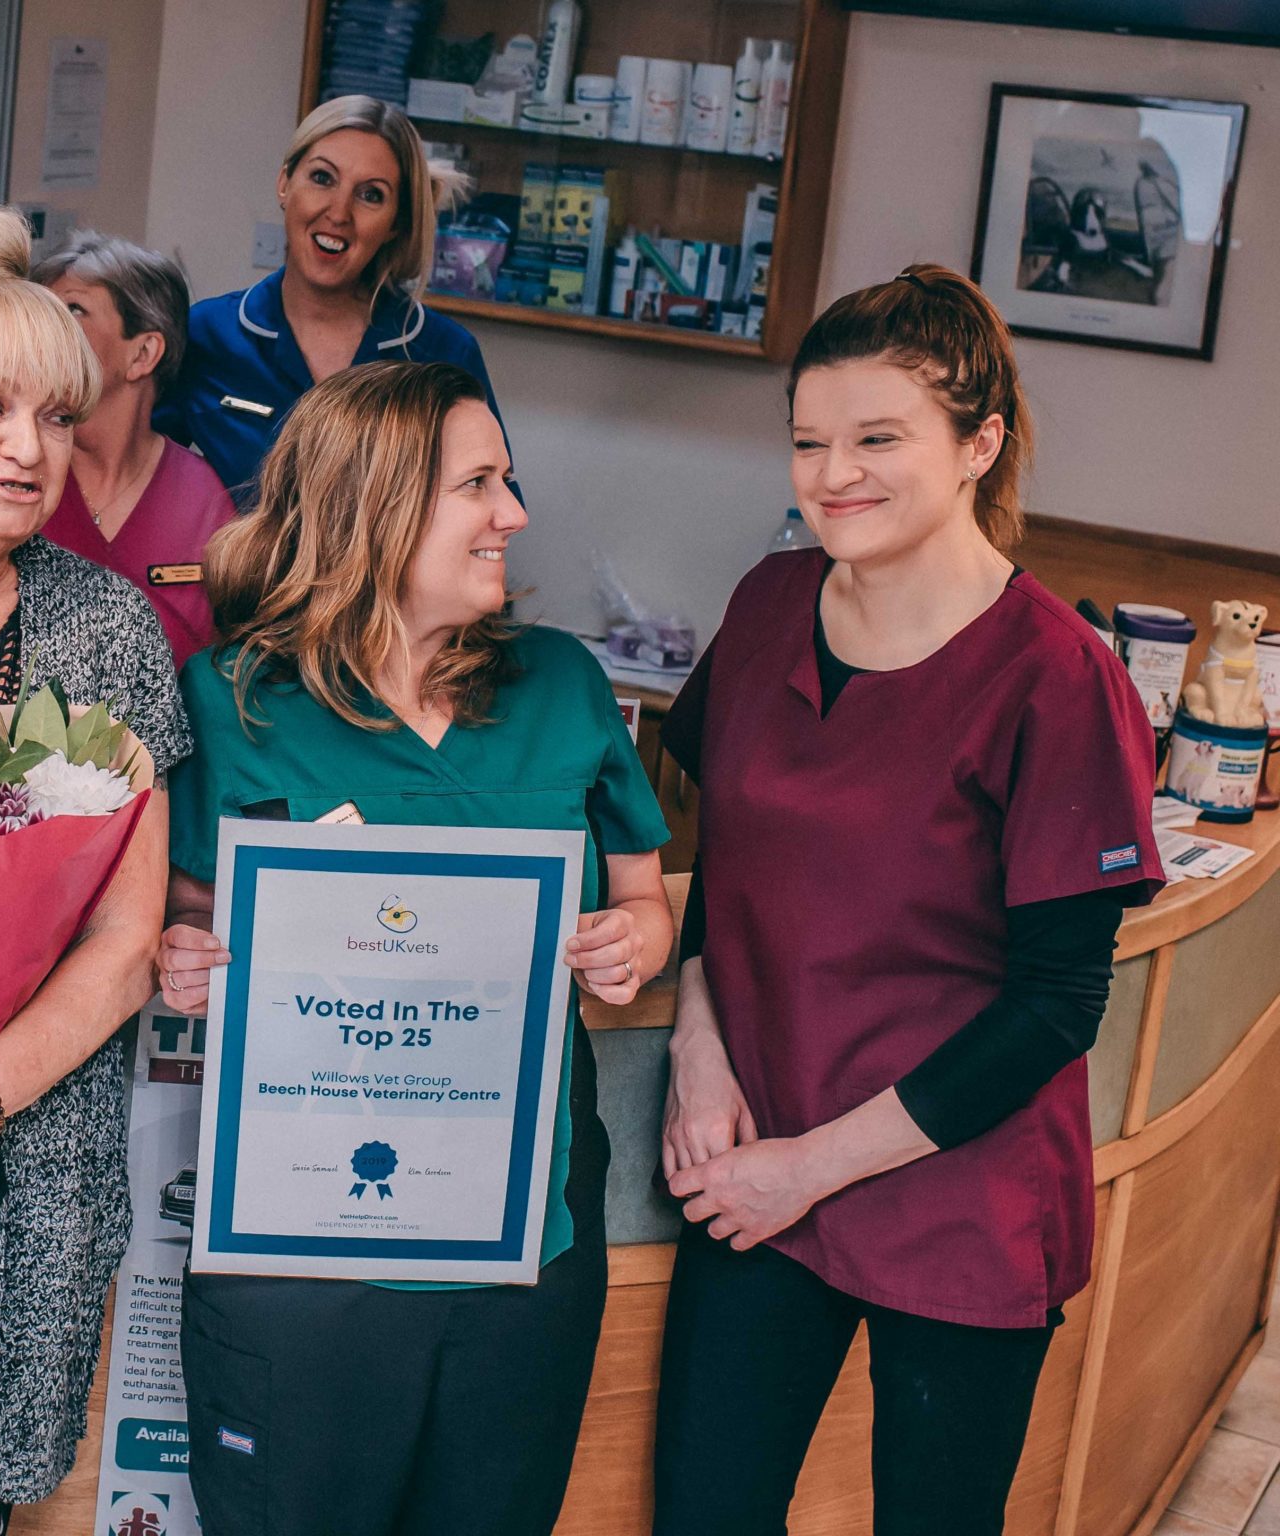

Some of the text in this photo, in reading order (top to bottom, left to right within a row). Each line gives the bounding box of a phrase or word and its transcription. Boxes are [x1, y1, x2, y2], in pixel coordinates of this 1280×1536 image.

[347, 936, 439, 954] bestUKvets
[295, 994, 480, 1022] Voted In The
[339, 1024, 433, 1051] Top 25
[311, 1070, 452, 1089] Willows Vet Group
[258, 1082, 501, 1103] Beech House Veterinary Centre
[361, 1156, 387, 1166] 2019
[339, 1213, 399, 1222] VetHelpDirect.com
[315, 1221, 368, 1229] INDEPENDENT
[132, 1274, 183, 1287] The Will
[129, 1300, 182, 1313] difficult to
[128, 1312, 172, 1325] different
[128, 1325, 180, 1339] £25 regar
[126, 1339, 178, 1350] treatment
[125, 1352, 146, 1363] The
[148, 1357, 166, 1365] van
[124, 1366, 148, 1376] ideal
[151, 1367, 166, 1377] for
[123, 1379, 179, 1391] euthanasia.
[121, 1392, 145, 1401] card
[160, 1450, 190, 1464] and
